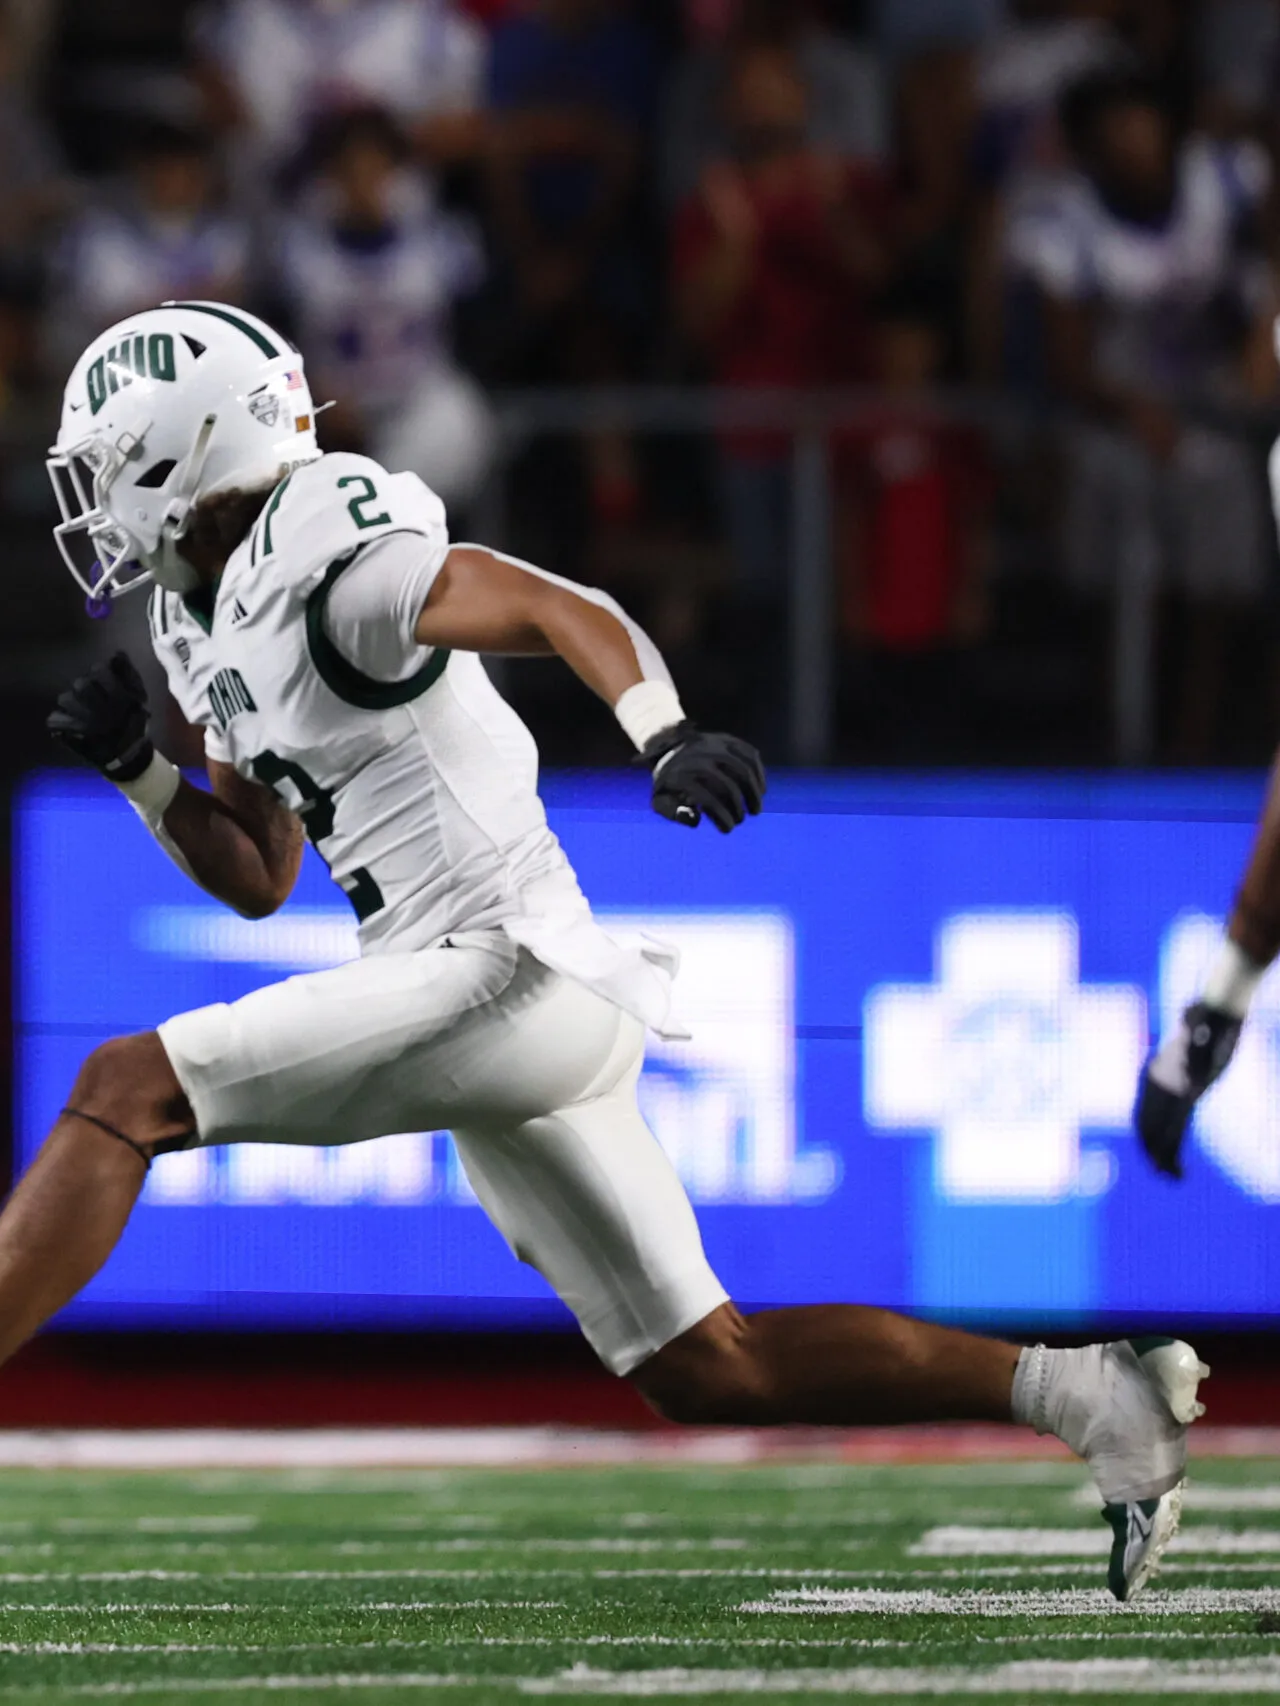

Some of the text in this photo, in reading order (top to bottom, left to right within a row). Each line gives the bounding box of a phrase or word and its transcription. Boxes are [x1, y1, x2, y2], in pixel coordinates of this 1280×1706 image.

[86, 333, 176, 416] OHIO
[337, 475, 392, 530] 2
[207, 667, 258, 731] OHIO
